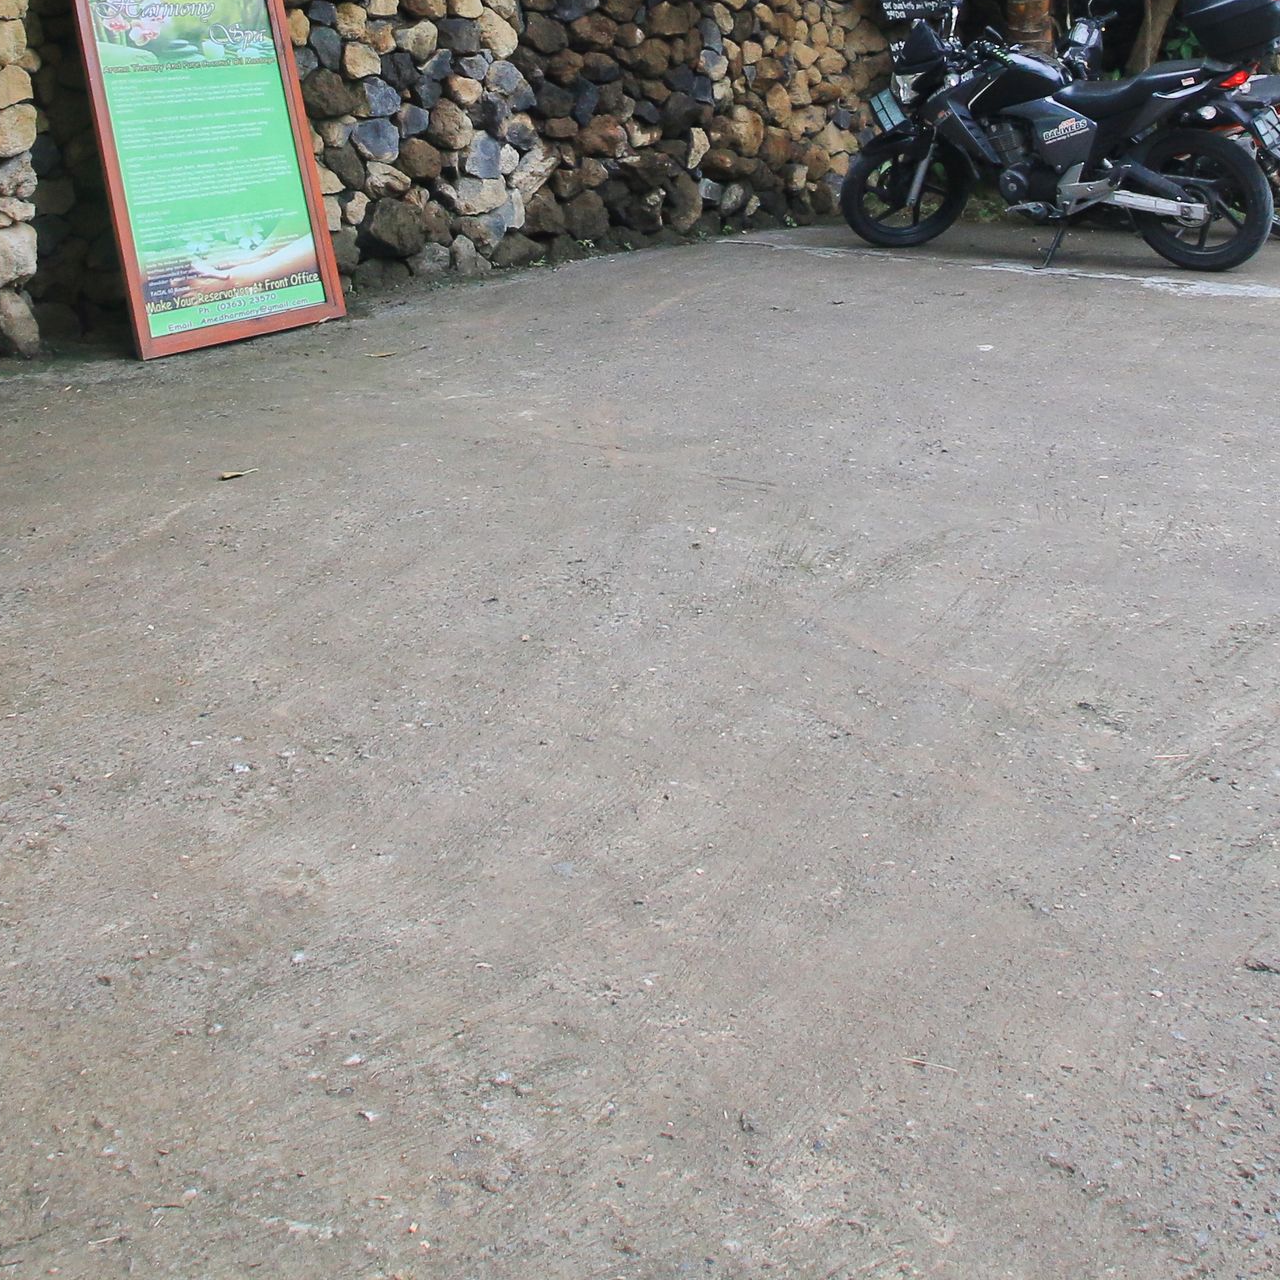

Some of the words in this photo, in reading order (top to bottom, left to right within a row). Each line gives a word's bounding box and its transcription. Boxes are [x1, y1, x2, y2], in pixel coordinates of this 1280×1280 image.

[208, 23, 267, 52] Spa
[131, 63, 164, 73] Therapy
[1043, 119, 1088, 140] BALIWEBS
[145, 299, 173, 315] Make
[173, 296, 198, 308] Your
[198, 285, 254, 304] Reservation
[265, 277, 289, 291] Front
[290, 272, 320, 286] Office
[216, 299, 246, 312] (0363)
[249, 293, 277, 305] 23570
